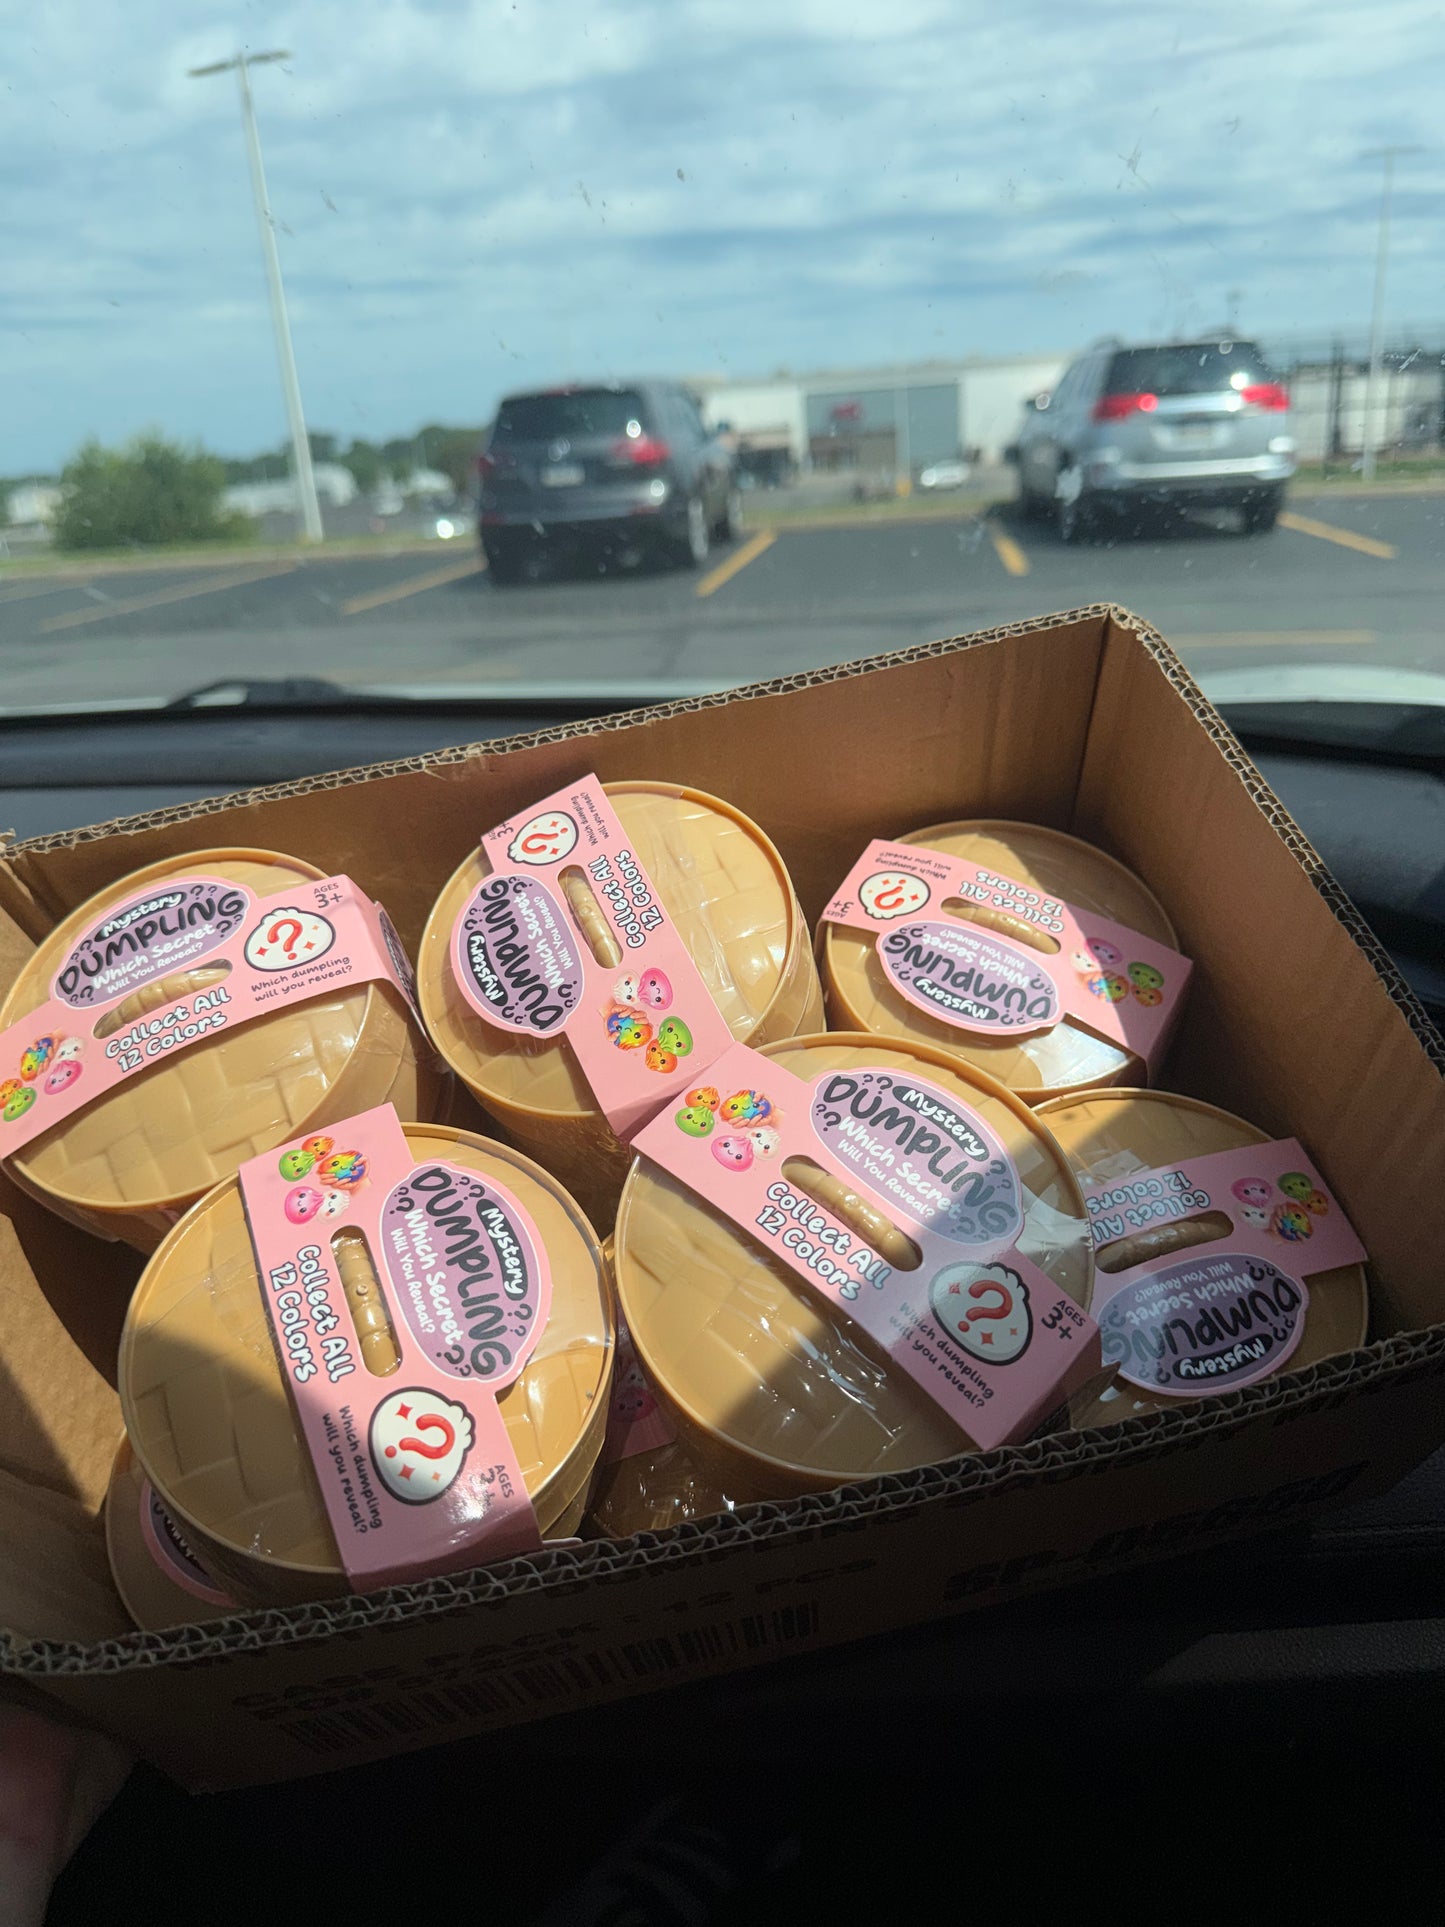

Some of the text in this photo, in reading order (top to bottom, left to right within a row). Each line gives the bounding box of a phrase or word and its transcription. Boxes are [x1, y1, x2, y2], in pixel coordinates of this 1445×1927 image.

[571, 795, 598, 846] Which dumpling
[580, 792, 609, 839] will you reveal?
[314, 883, 339, 896] AGES
[614, 850, 664, 932] 12 Colors
[875, 857, 947, 879] Which dumpling
[880, 851, 951, 870] will you reveal?
[101, 892, 181, 938] Mystery
[316, 892, 343, 909] 3+
[588, 854, 646, 948] Collect All
[833, 901, 854, 913] 3+
[959, 881, 1064, 933] Collect All
[975, 871, 1064, 917] 12 Colors
[56, 891, 245, 995] DUMPLING
[91, 924, 216, 989] Which Secret
[480, 880, 563, 1029] DUMPLING
[514, 892, 565, 989] Which Secret
[534, 896, 574, 969] Will You Reveal?
[922, 933, 1030, 988] Which Secret
[939, 929, 1025, 970] Will You Reveal?
[106, 942, 204, 995] Will You Reveal?
[250, 955, 351, 994] Which dumpling
[254, 965, 353, 1002] will you reveal?
[470, 935, 503, 1000] Mystery
[884, 933, 1050, 1019] DUMPLING
[916, 978, 990, 1019] Mystery
[105, 986, 231, 1059] Collect All
[117, 1010, 227, 1073] 12 Colors
[823, 1075, 1016, 1234] DUMPLING
[902, 1089, 985, 1157] Mystery
[838, 1116, 962, 1218] Which Secret
[838, 1139, 935, 1218] Will You Reveal?
[1085, 1170, 1192, 1215] 12 Colors
[767, 1182, 892, 1290] Collect All
[1091, 1189, 1210, 1243] Collect All
[390, 1228, 435, 1333] Will You Reveal?
[404, 1208, 464, 1345] Which Secret
[411, 1168, 511, 1375] DUMPLING
[481, 1208, 524, 1294] Mystery
[755, 1205, 861, 1300] 12 Colors
[1134, 1262, 1233, 1303] Will You Reveal?
[270, 1261, 318, 1383] 12 Colors
[297, 1245, 356, 1383] Collect All
[1041, 1306, 1073, 1341] 3+
[1056, 1299, 1086, 1328] AGES
[1102, 1277, 1301, 1365] DUMPLING
[1126, 1272, 1257, 1326] Which Secret
[889, 1316, 985, 1409] will you reveal?
[899, 1302, 994, 1399] Which dumpling
[1179, 1338, 1266, 1376] Mystery
[322, 1414, 367, 1533] will you reveal?
[339, 1405, 383, 1529] Which dumpling
[495, 1464, 515, 1498] AGES
[423, 1619, 600, 1667] PACK
[754, 1556, 878, 1595] PCS
